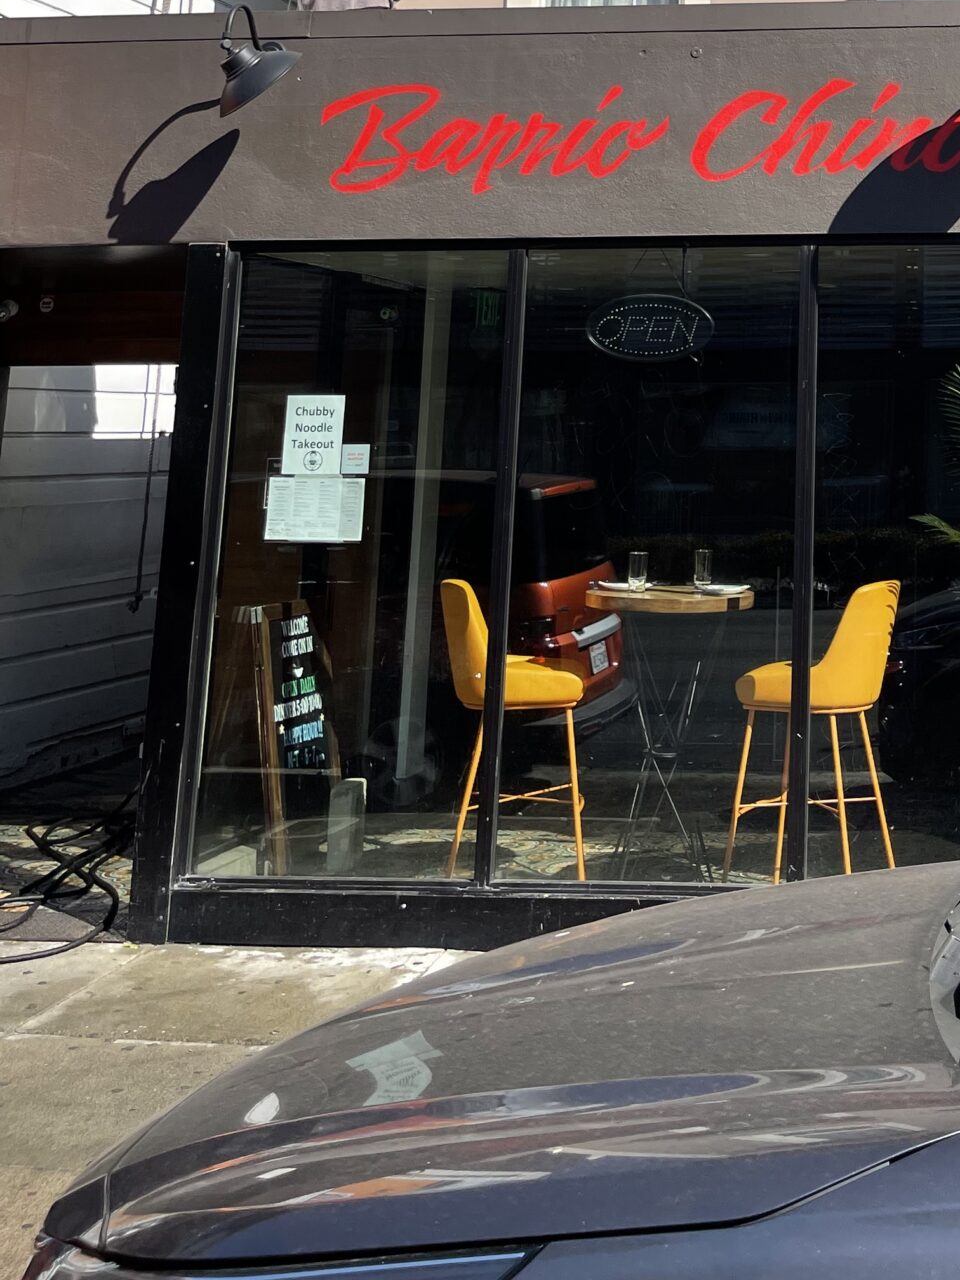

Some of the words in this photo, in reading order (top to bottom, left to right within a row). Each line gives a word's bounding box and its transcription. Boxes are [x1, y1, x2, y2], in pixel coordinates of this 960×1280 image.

[321, 83, 669, 195] Barrio
[596, 315, 700, 343] OPEN
[295, 405, 336, 419] Chubby
[295, 422, 333, 433] Noodle
[291, 438, 335, 449] Takeout
[281, 615, 309, 636] WELCOME
